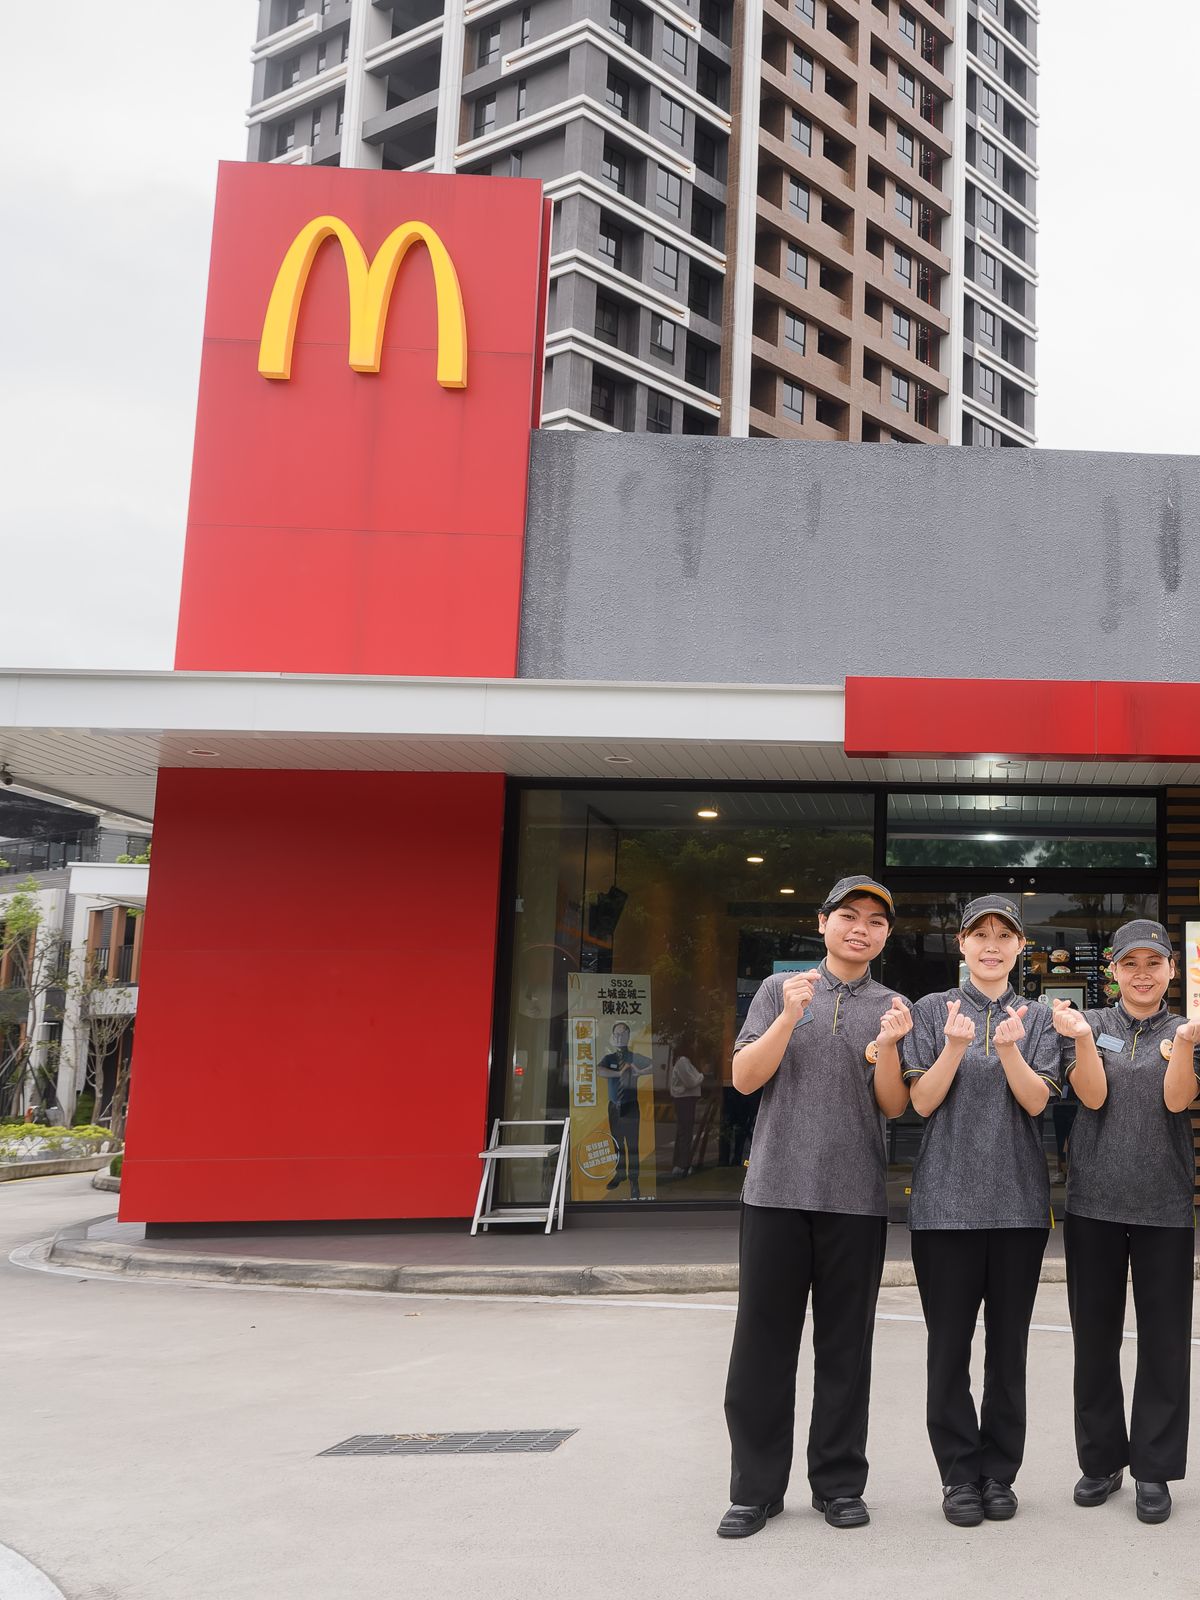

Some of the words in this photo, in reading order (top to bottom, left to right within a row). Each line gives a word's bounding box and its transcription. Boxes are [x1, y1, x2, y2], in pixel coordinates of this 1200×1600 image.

[610, 978, 634, 988] S532
[597, 988, 647, 999] 土城金城二
[602, 1000, 642, 1015] 陳松文
